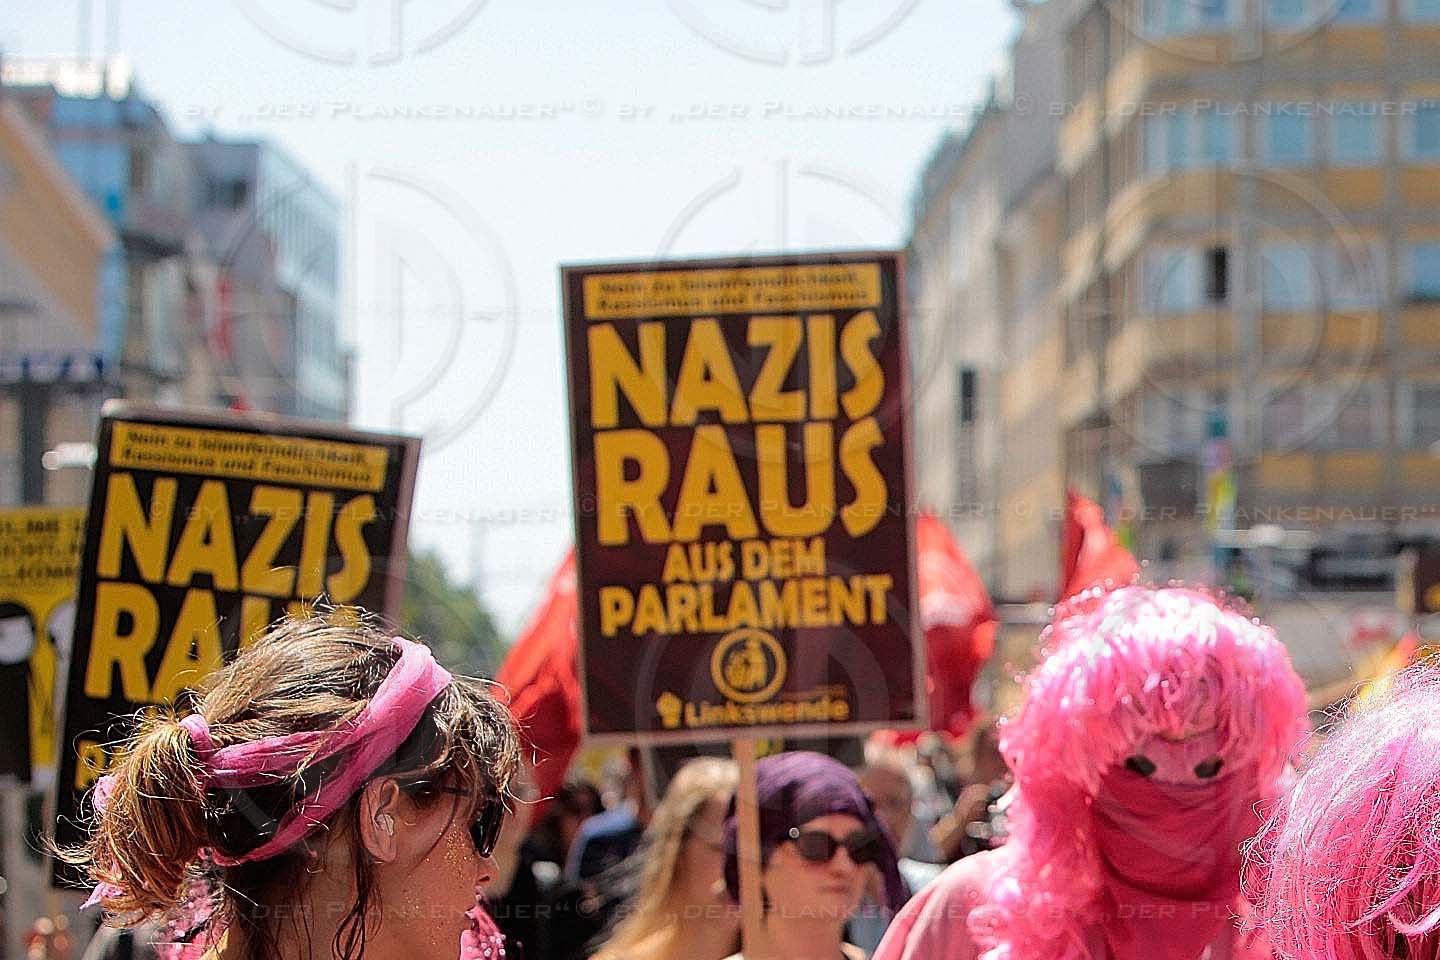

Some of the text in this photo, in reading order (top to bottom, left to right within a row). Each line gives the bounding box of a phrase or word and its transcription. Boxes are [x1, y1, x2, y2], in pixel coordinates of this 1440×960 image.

[587, 310, 886, 430] NAZIS
[97, 473, 377, 602] NAZIS
[593, 416, 888, 546] RAUS
[599, 573, 894, 638] PARLAMENT
[661, 536, 827, 583] AUS DEM
[84, 581, 362, 704] RA
